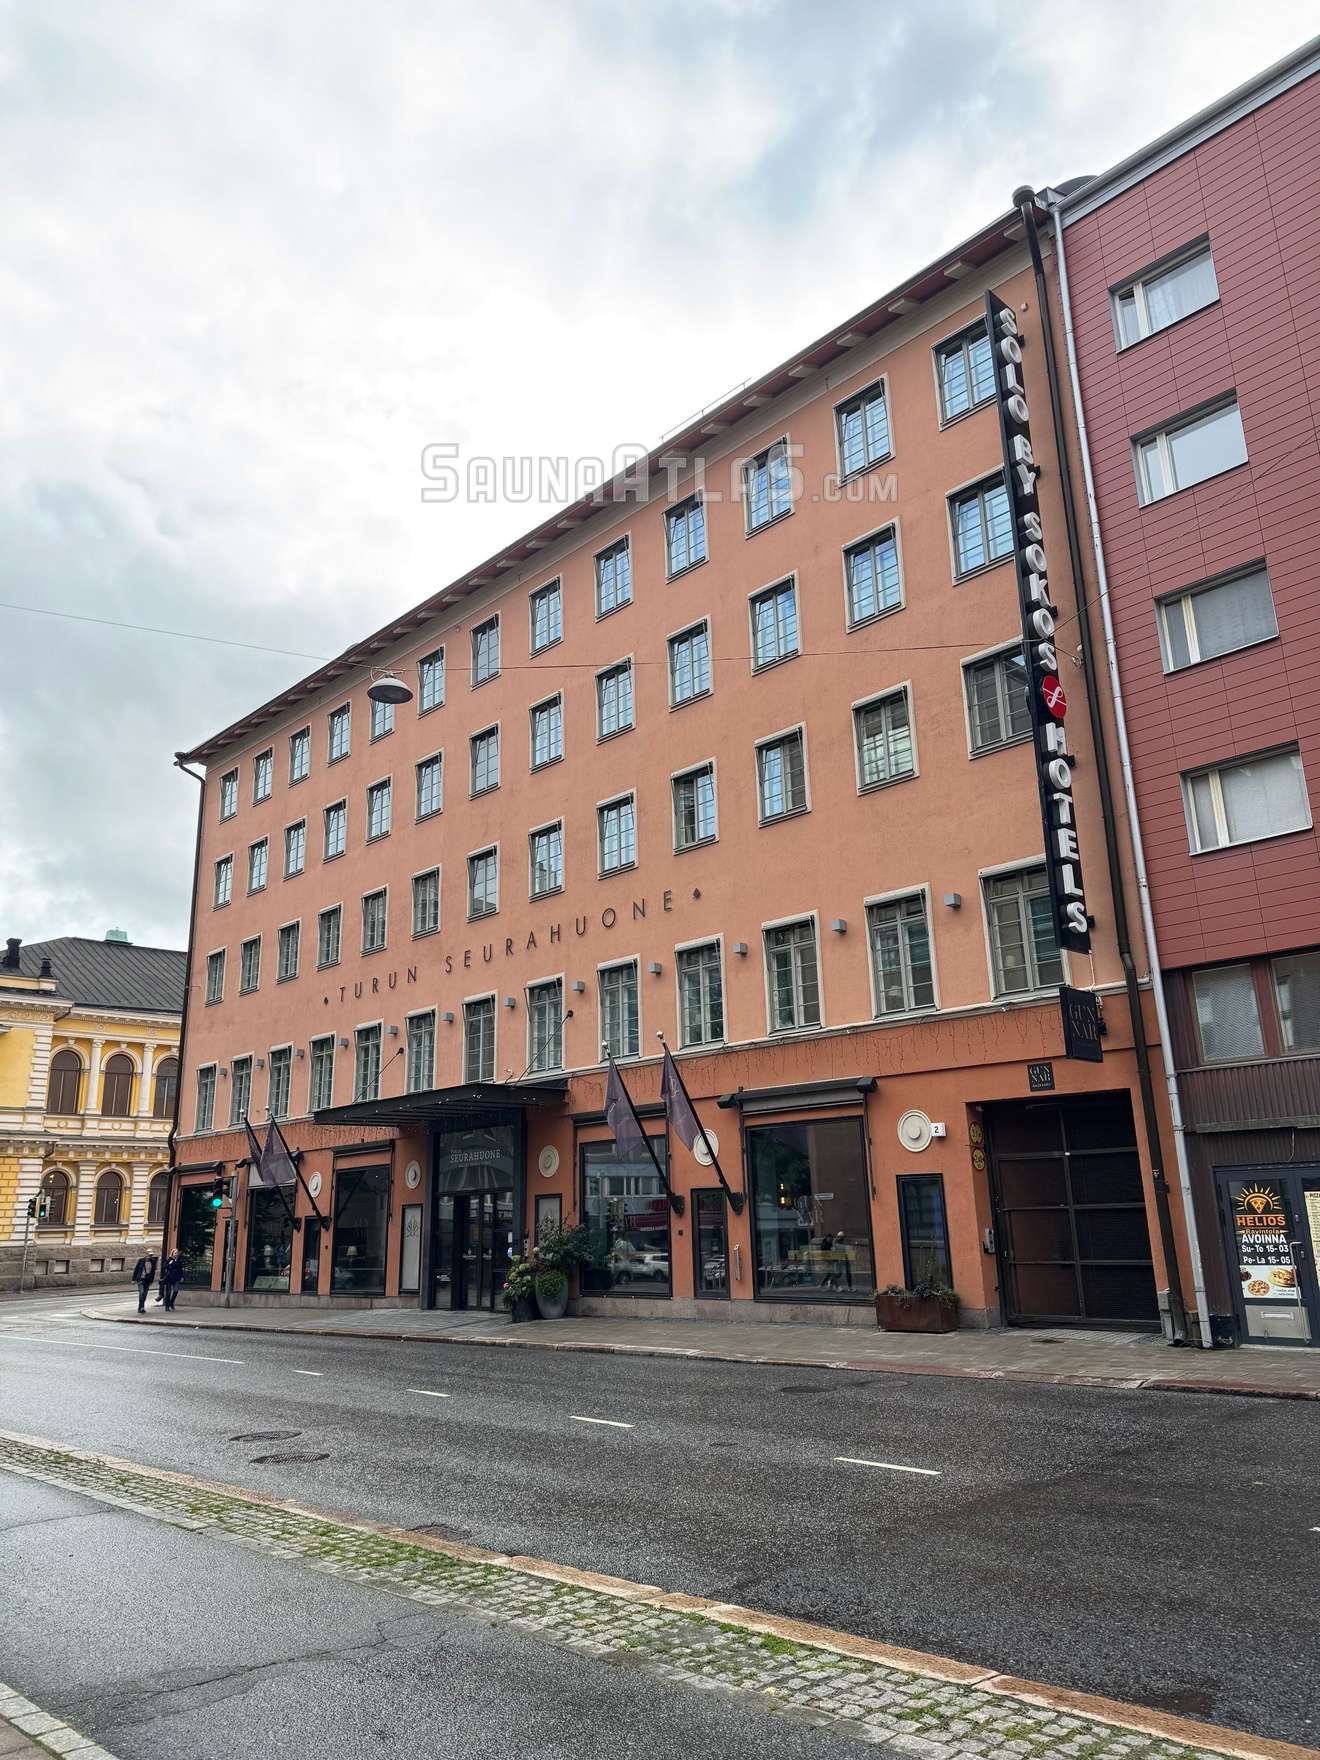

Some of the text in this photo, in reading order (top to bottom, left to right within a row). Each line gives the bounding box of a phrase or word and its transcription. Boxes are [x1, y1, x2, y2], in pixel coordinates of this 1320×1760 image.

[999, 307, 1088, 933] SOLO BY SOKOS HOTELS
[339, 889, 673, 1002] TURUN SEURAHUONE
[934, 1126, 940, 1134] 2
[1236, 1216, 1286, 1226] HELIOS
[1241, 1234, 1287, 1243] AVOINNA
